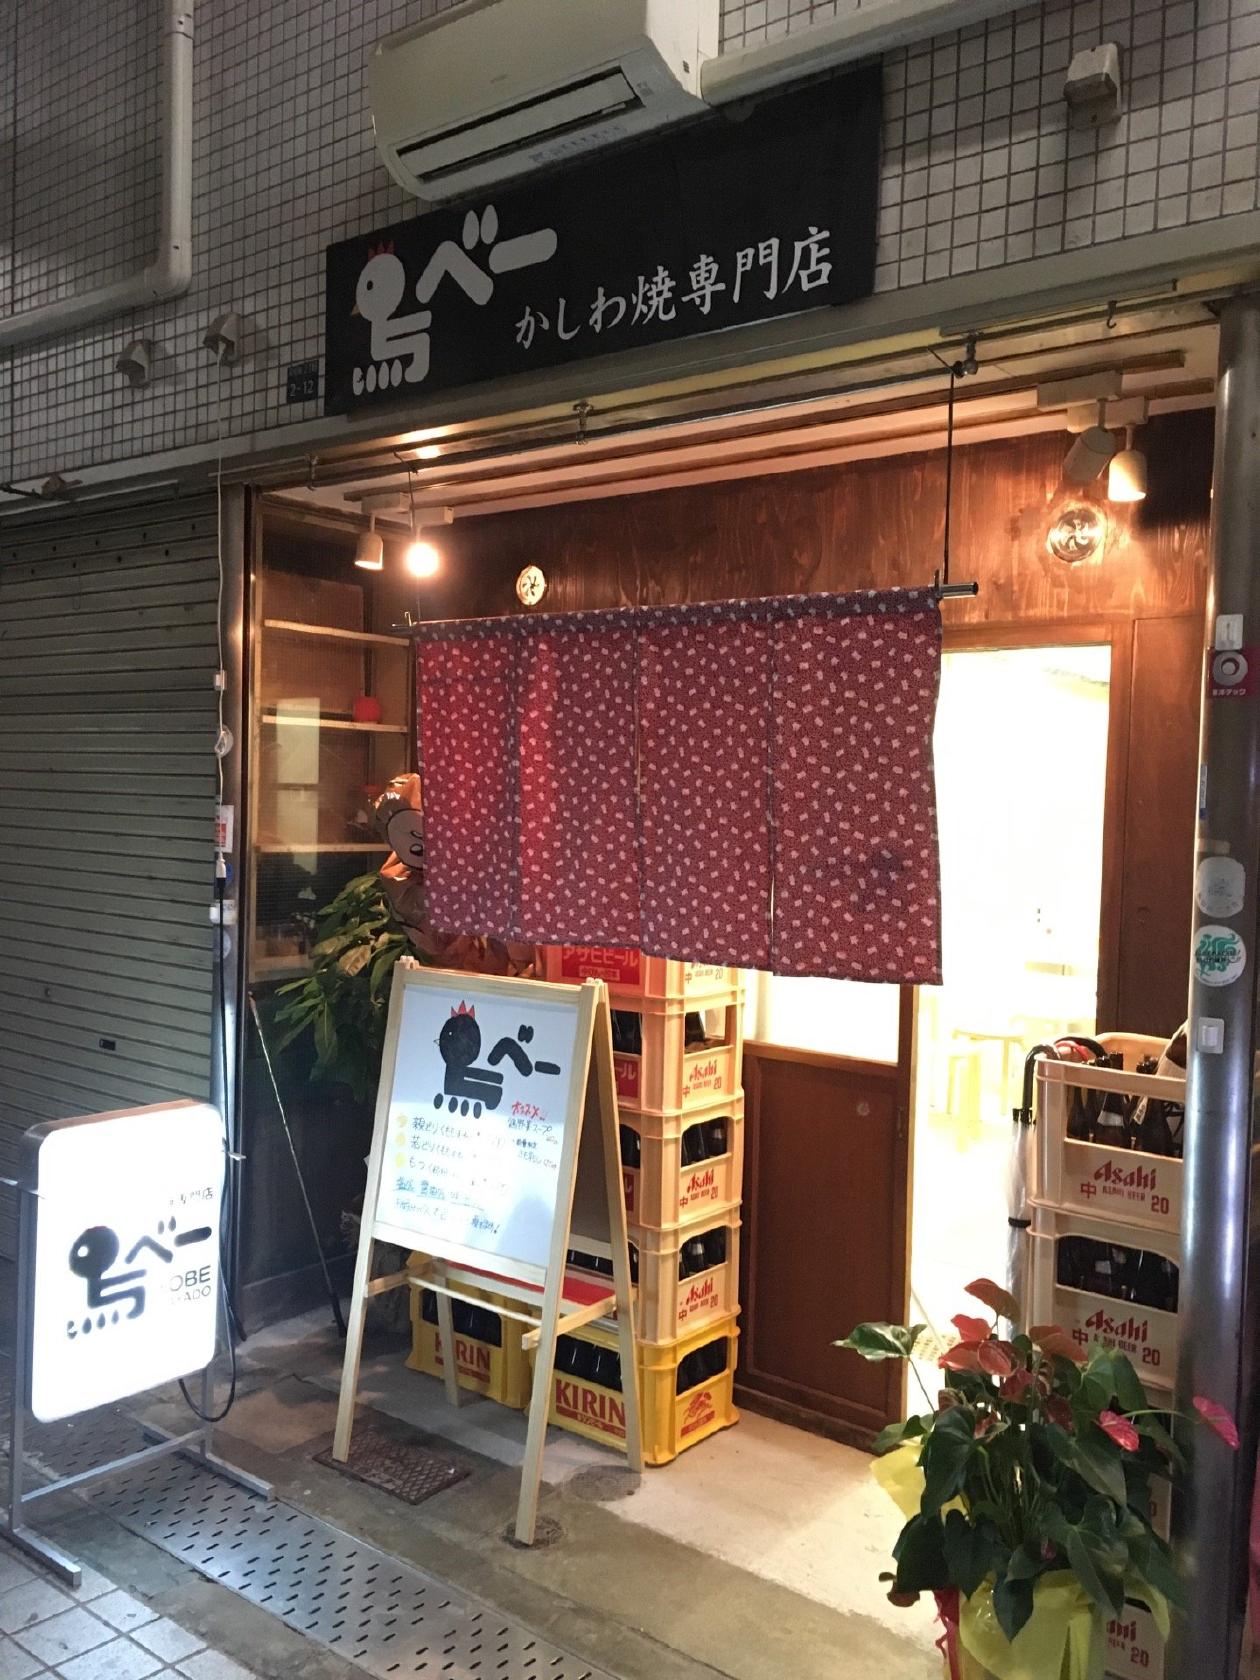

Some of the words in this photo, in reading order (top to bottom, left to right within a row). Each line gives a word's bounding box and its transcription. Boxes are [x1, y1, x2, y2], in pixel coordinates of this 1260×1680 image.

[515, 226, 833, 350] かしわ焼専門店
[687, 1168, 714, 1193] Asahi
[1094, 1160, 1156, 1191] Asahi
[1081, 1181, 1096, 1199] 中
[1151, 1195, 1169, 1215] 20
[686, 1276, 713, 1305] Asahi
[1085, 1309, 1148, 1343] Asahi
[435, 1332, 491, 1372] KRIN
[1072, 1328, 1088, 1346] 中
[1142, 1346, 1160, 1366] 20
[556, 1378, 626, 1428] KIRIN
[1130, 1646, 1149, 1668] 20
